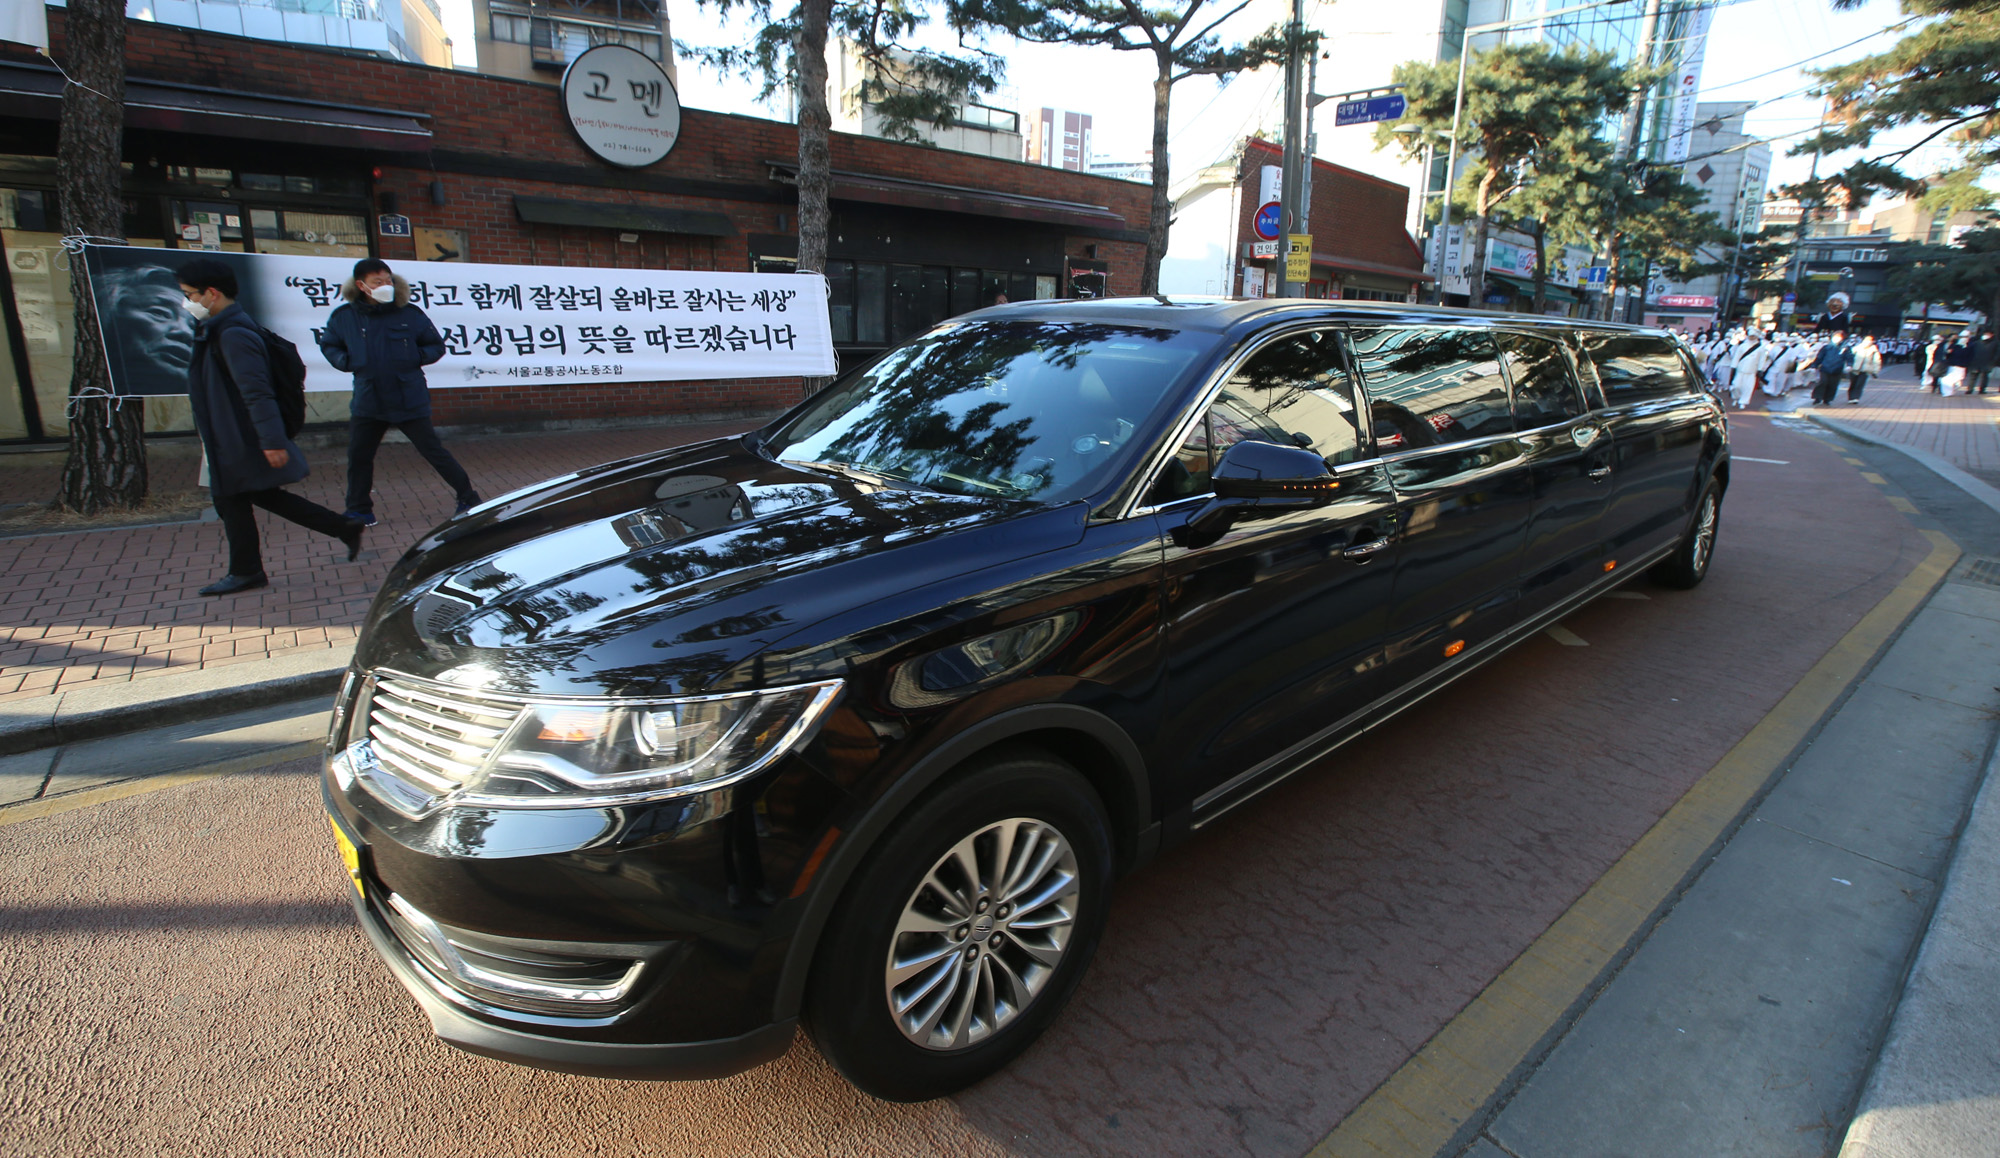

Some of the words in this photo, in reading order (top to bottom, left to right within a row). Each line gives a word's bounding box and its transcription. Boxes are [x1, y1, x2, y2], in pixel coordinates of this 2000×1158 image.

[582, 70, 663, 118] 고멘
[1338, 102, 1368, 116] 대명1길
[1260, 217, 1279, 225] 주차금
[388, 224, 402, 234] 13
[467, 283, 523, 311] 함께
[529, 284, 603, 312] 잘살되
[609, 286, 679, 313] 올바로
[683, 287, 747, 313] 잘사는
[442, 324, 567, 356] 선생님의
[578, 324, 636, 355] 뜻을
[643, 323, 797, 354] 따르겠습니다
[507, 364, 624, 378] 서울교통공사노동조합
